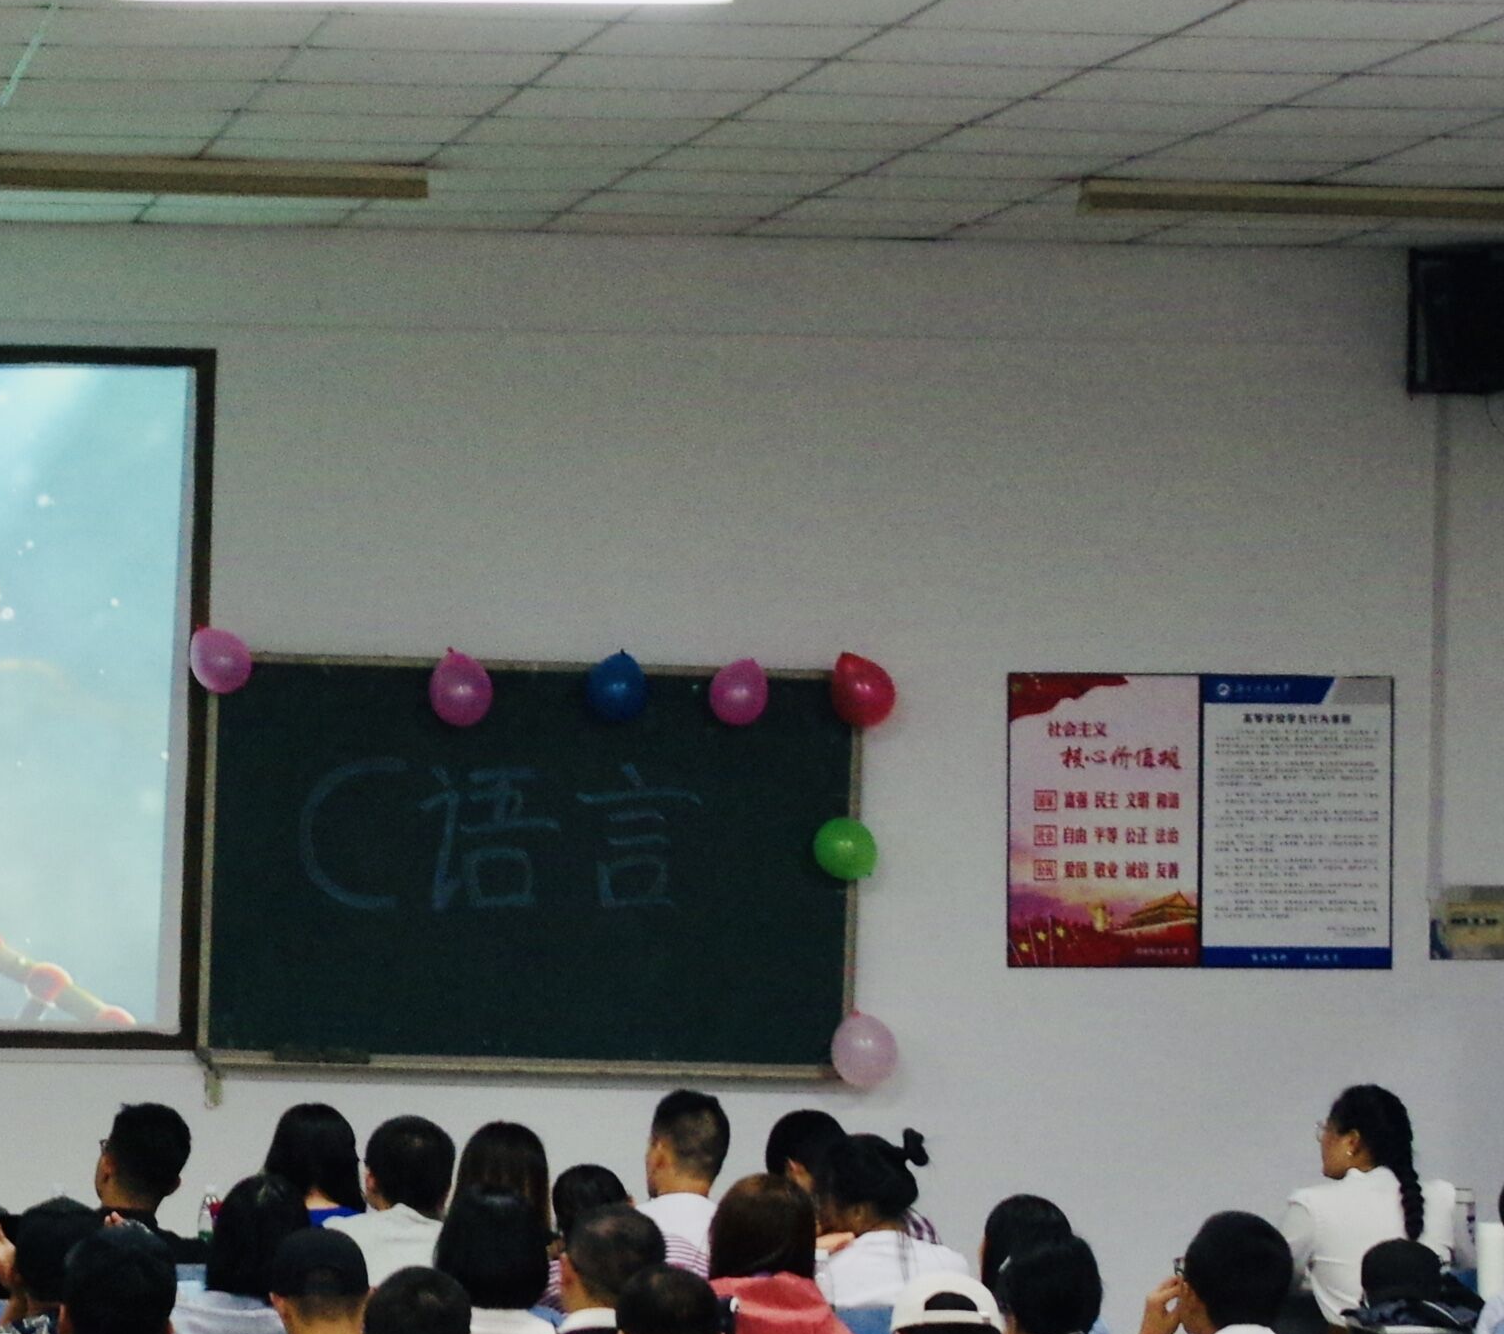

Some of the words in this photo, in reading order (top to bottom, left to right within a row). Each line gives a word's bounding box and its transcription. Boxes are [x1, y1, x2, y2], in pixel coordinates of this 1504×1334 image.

[1048, 721, 1108, 738] 社会主义
[1094, 790, 1119, 809] 民主
[1063, 826, 1088, 845] 自由
[1094, 826, 1118, 845] 平等
[1125, 826, 1148, 845] 公正
[1154, 826, 1179, 845] 法治
[1125, 861, 1150, 879] 诚信
